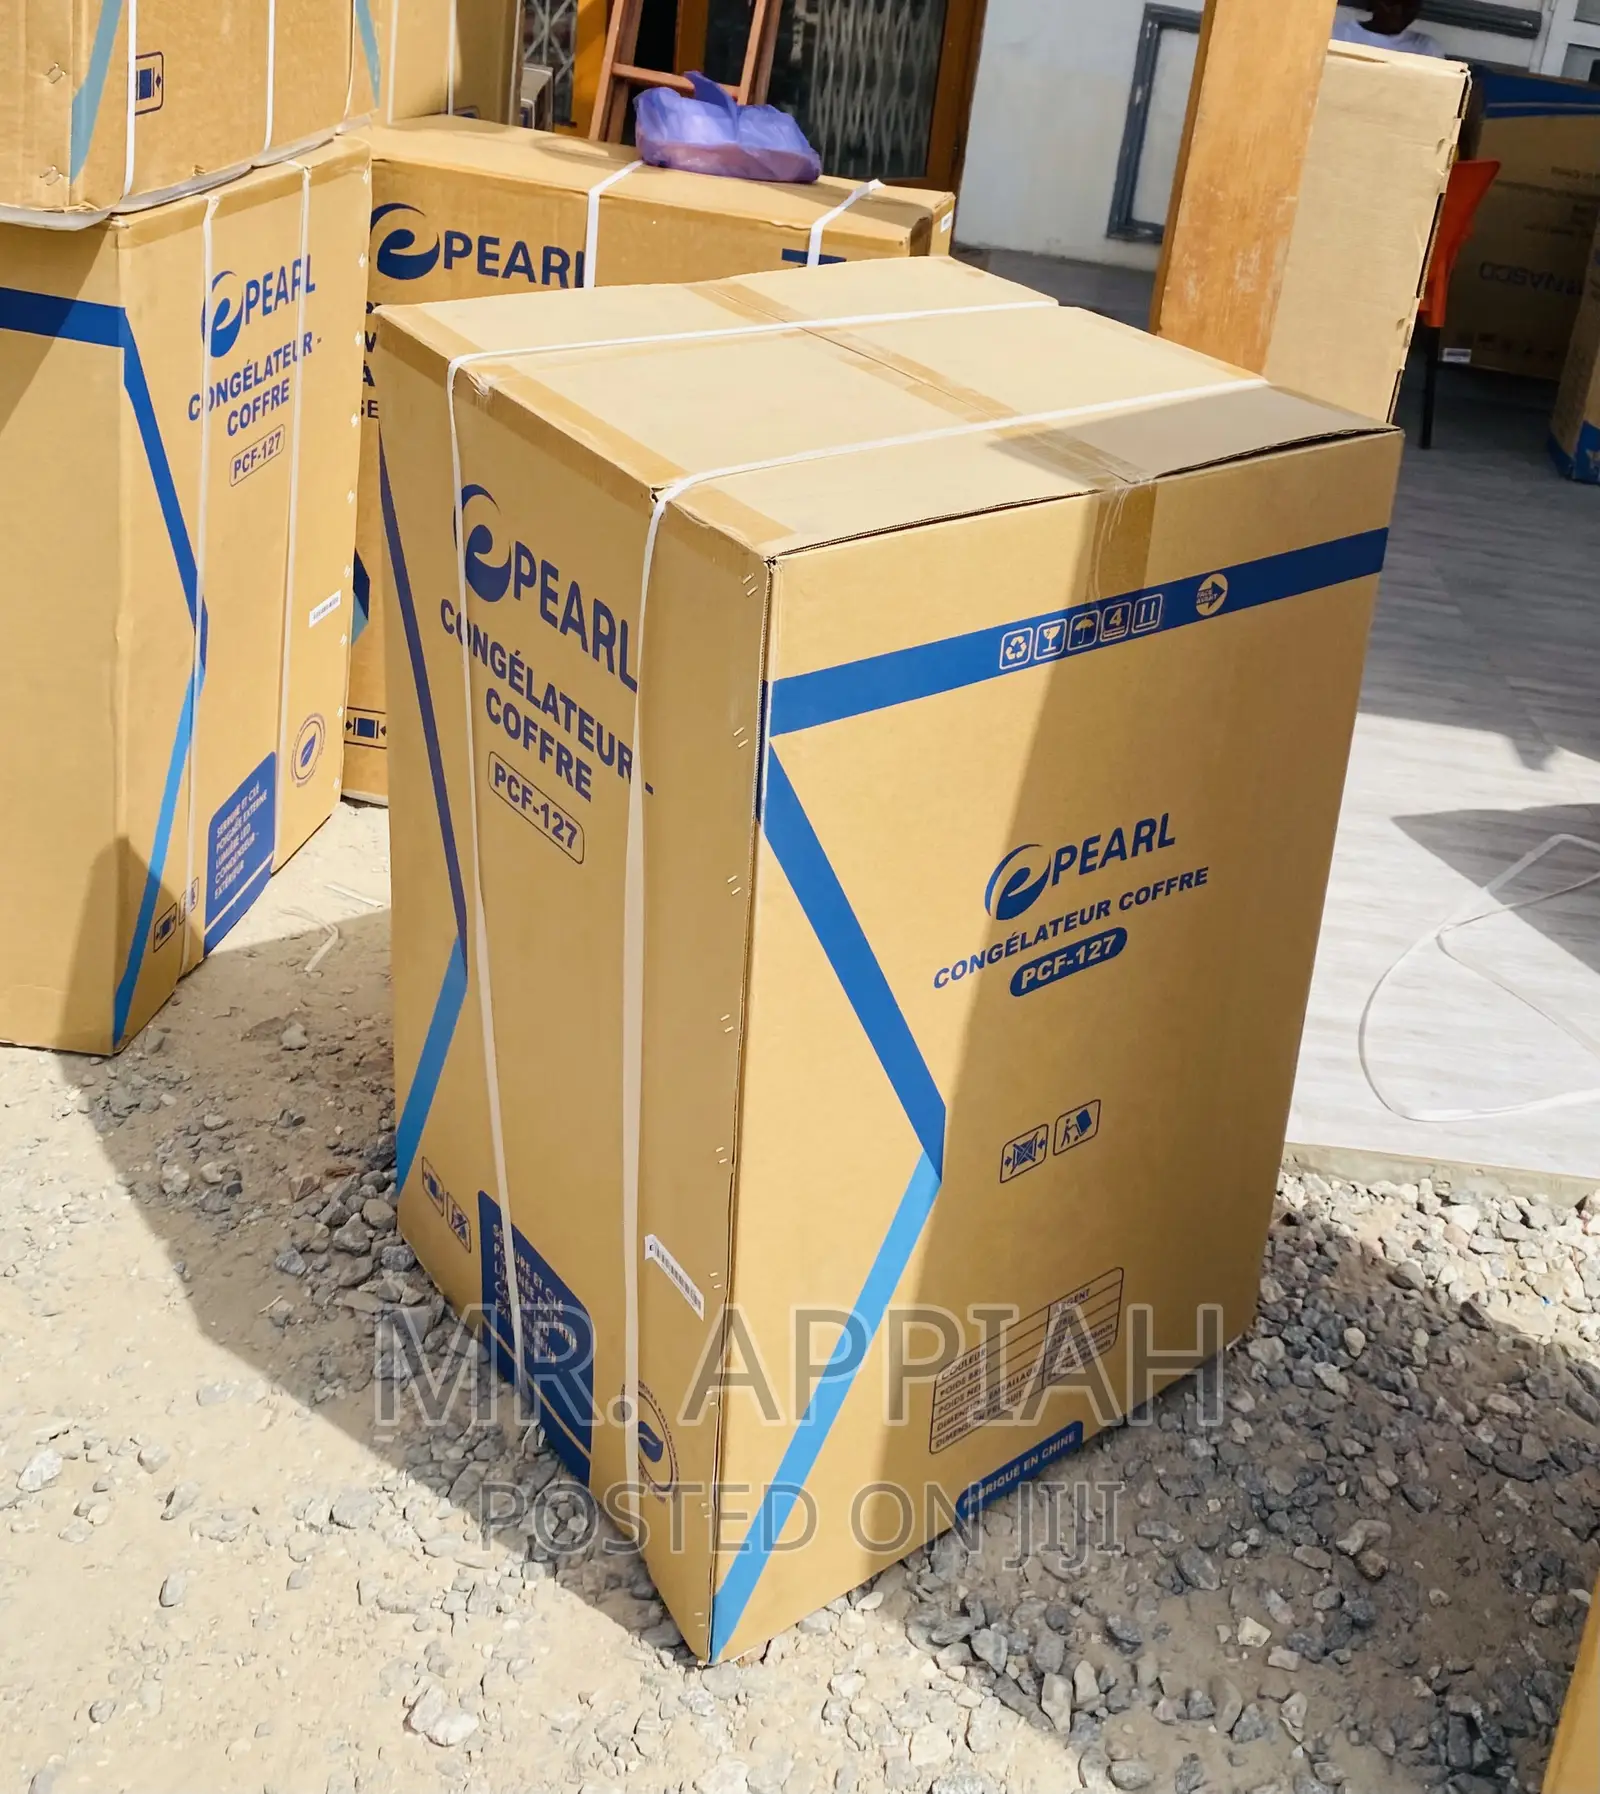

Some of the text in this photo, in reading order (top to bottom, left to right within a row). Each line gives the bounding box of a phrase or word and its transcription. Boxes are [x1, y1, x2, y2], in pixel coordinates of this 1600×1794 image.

[227, 378, 290, 437] COFFRE
[233, 432, 282, 480] PCF-127
[513, 540, 638, 694] PEARL
[485, 687, 592, 803] COFFRE
[494, 762, 578, 851] PCF-127
[1051, 813, 1176, 887] PEARL
[933, 866, 1209, 989] CONGÉLATEUR COFFRE
[1021, 933, 1117, 990] PCF-127
[1023, 1453, 1039, 1471] EN
[1042, 1430, 1076, 1459] CHINE
